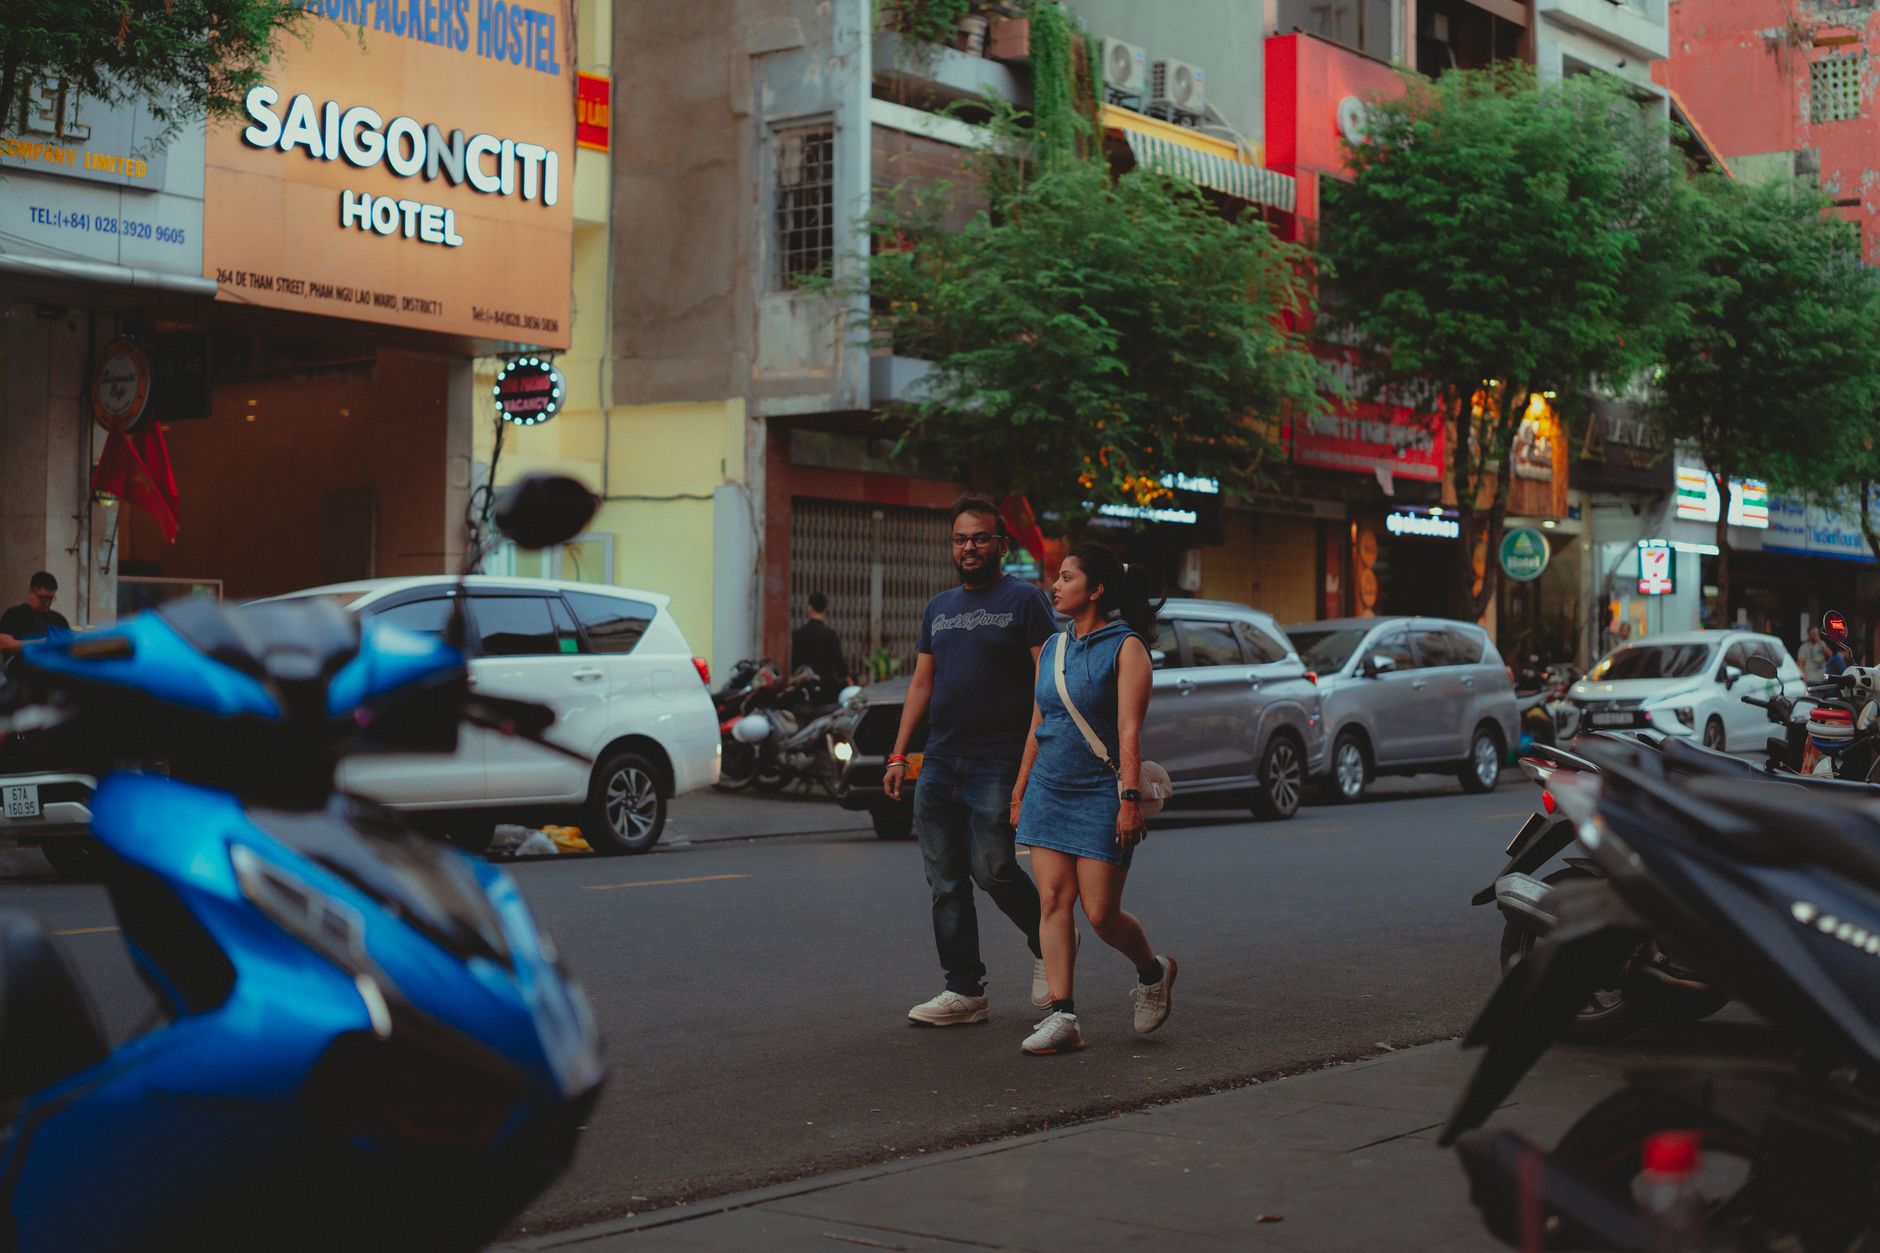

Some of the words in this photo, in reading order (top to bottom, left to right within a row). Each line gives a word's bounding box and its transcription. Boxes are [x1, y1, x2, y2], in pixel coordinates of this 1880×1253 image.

[476, 0, 560, 76] HOSTEL
[245, 84, 559, 207] SAIGONCITI
[85, 151, 147, 177] LIMITED
[341, 189, 464, 247] HOTEL
[156, 226, 185, 245] 9605
[217, 268, 233, 285] 264
[236, 270, 247, 288] DE
[249, 272, 274, 290] THAM
[309, 281, 334, 299] PHAM
[503, 396, 550, 413] VACANCY
[13, 787, 28, 800] 67A
